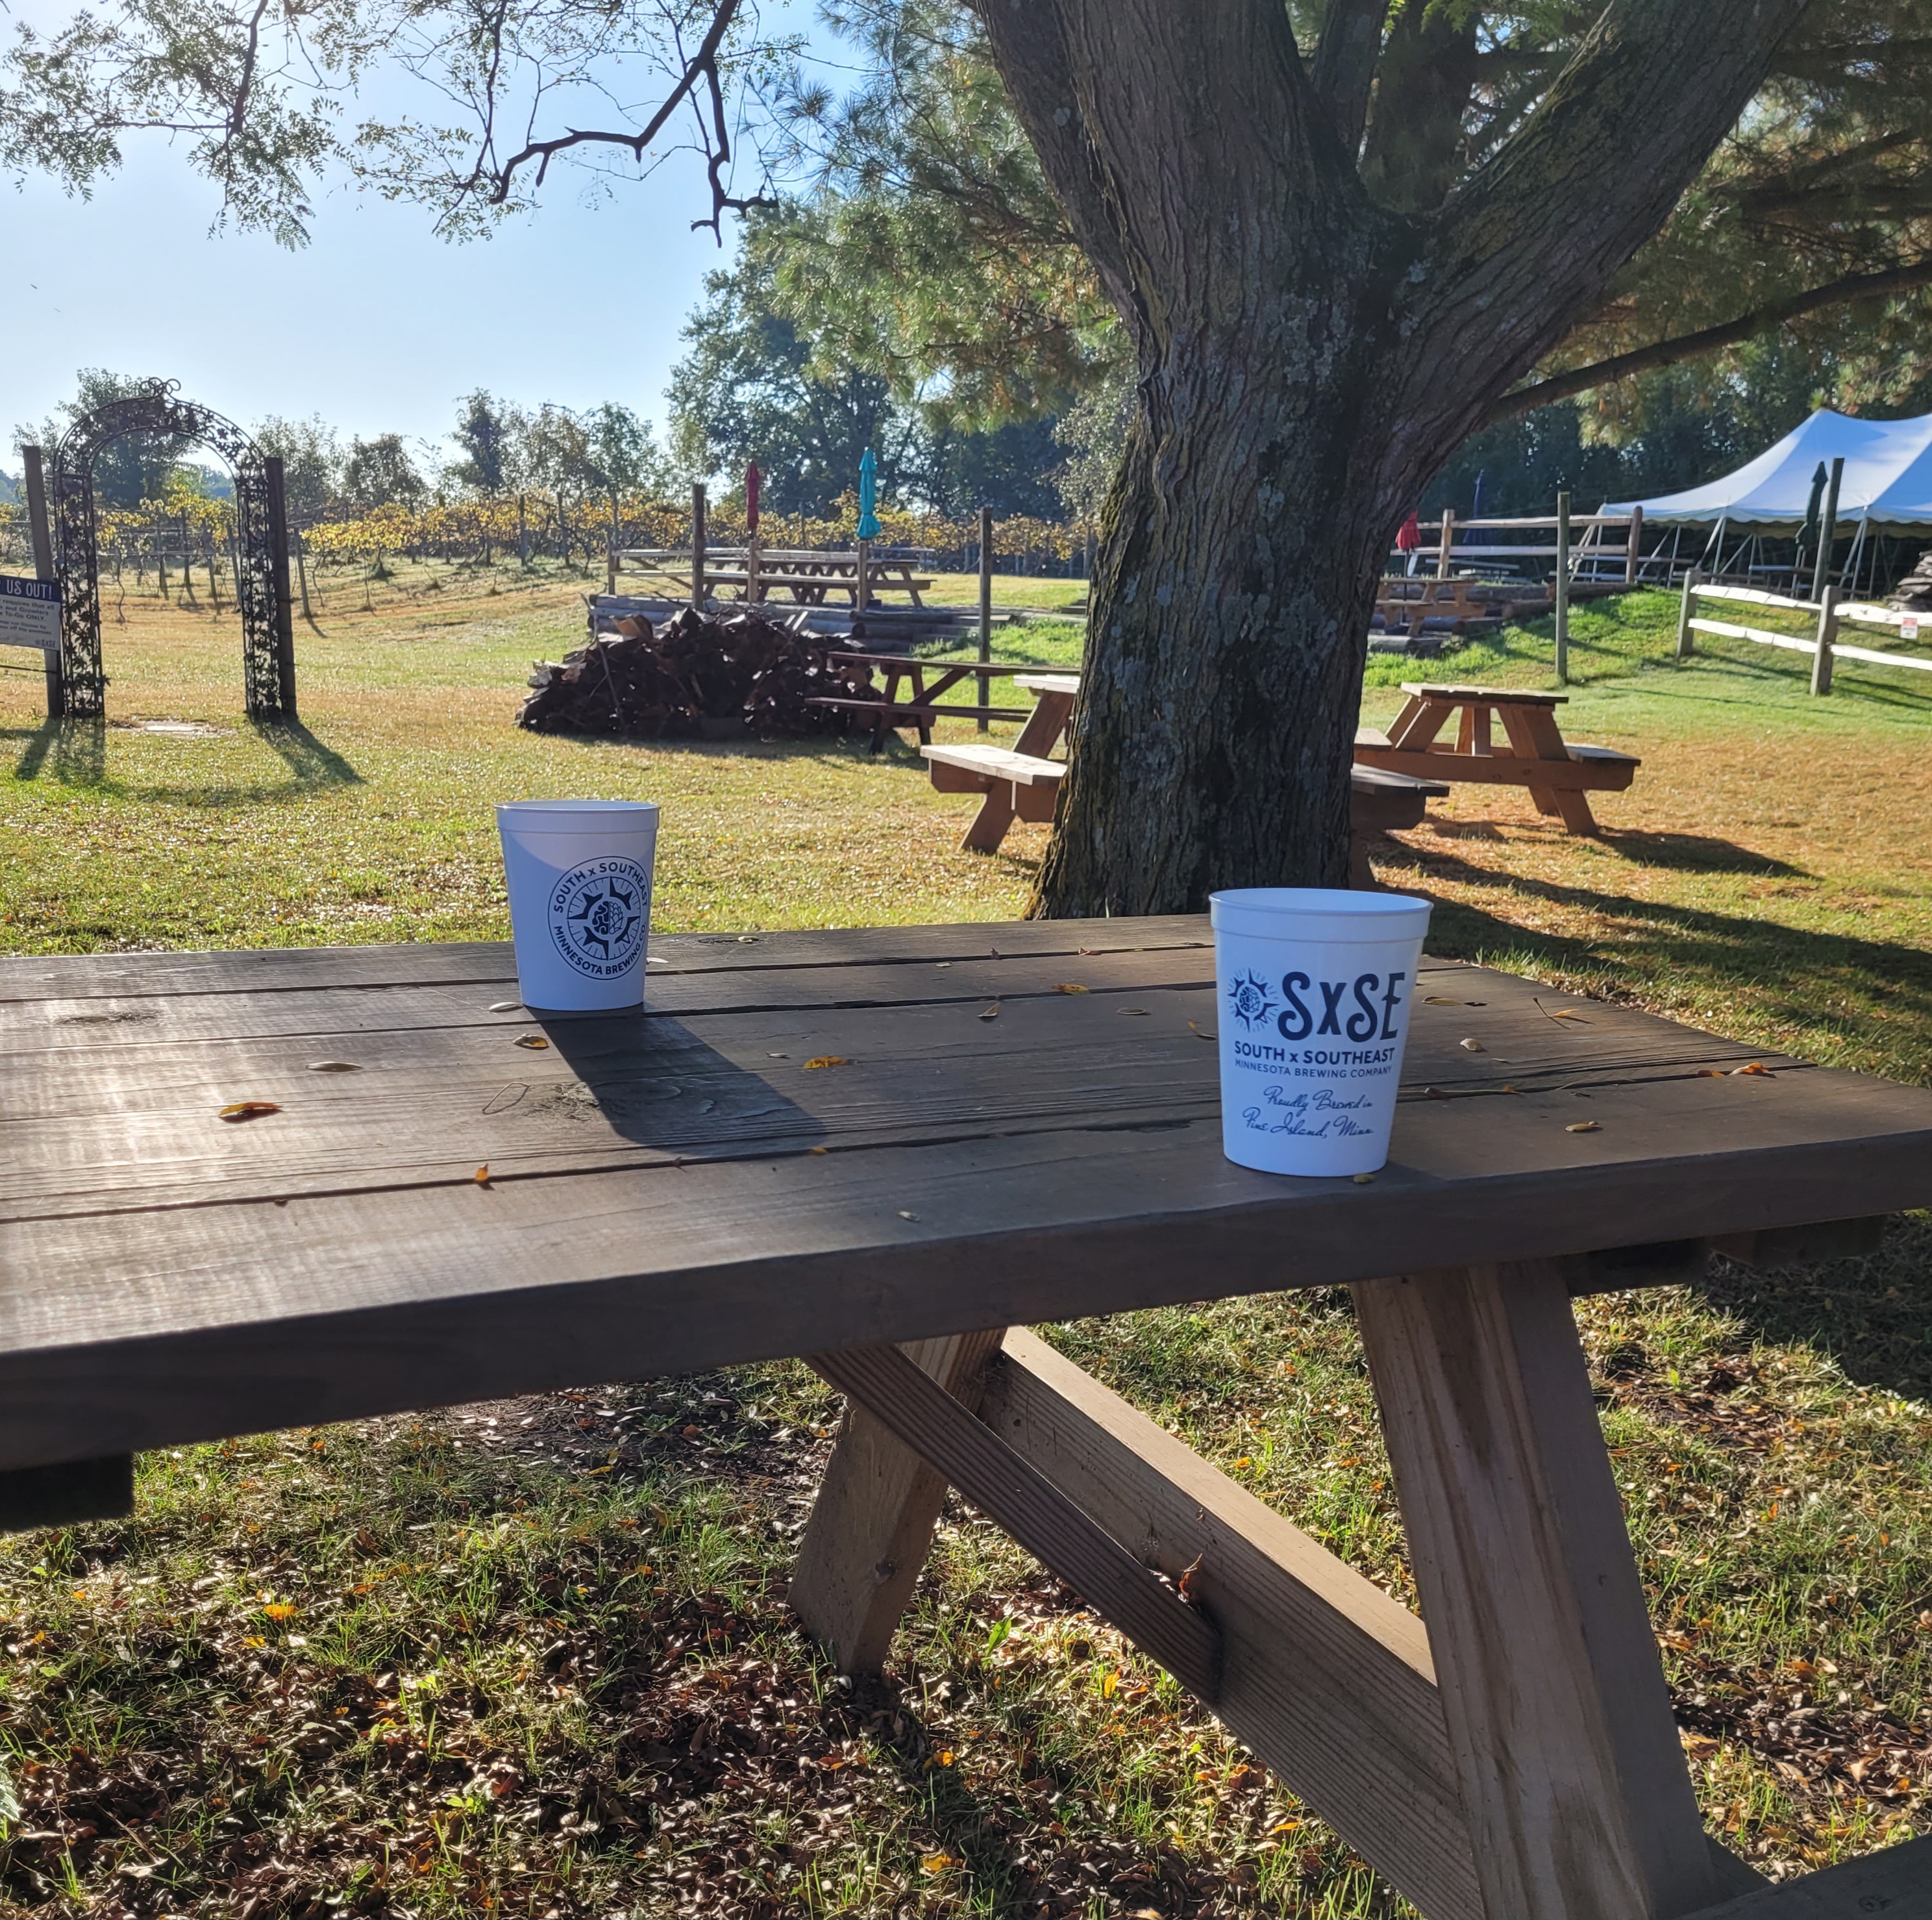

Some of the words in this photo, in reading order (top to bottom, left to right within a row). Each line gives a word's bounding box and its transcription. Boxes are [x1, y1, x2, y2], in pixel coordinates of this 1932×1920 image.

[6, 579, 21, 595] US
[26, 582, 51, 599] OUT!
[553, 870, 587, 914] SOUTH
[599, 862, 648, 906] SOUTHEAST
[553, 925, 603, 975] MINNESOTA
[605, 942, 641, 975] BREWING
[1234, 1040, 1285, 1062] SOUTH
[1302, 1047, 1395, 1066] SOUTHEAST
[1235, 1058, 1291, 1076] MINNESOTA
[1294, 1067, 1347, 1078] BREWING
[1350, 1065, 1392, 1078] COMPANY
[1263, 1085, 1309, 1117] Proudly
[1313, 1089, 1366, 1111] Brewed
[1361, 1100, 1373, 1109] in
[1242, 1106, 1269, 1132] Pine
[1270, 1112, 1331, 1139] Island,
[1333, 1115, 1375, 1137] Minn.
